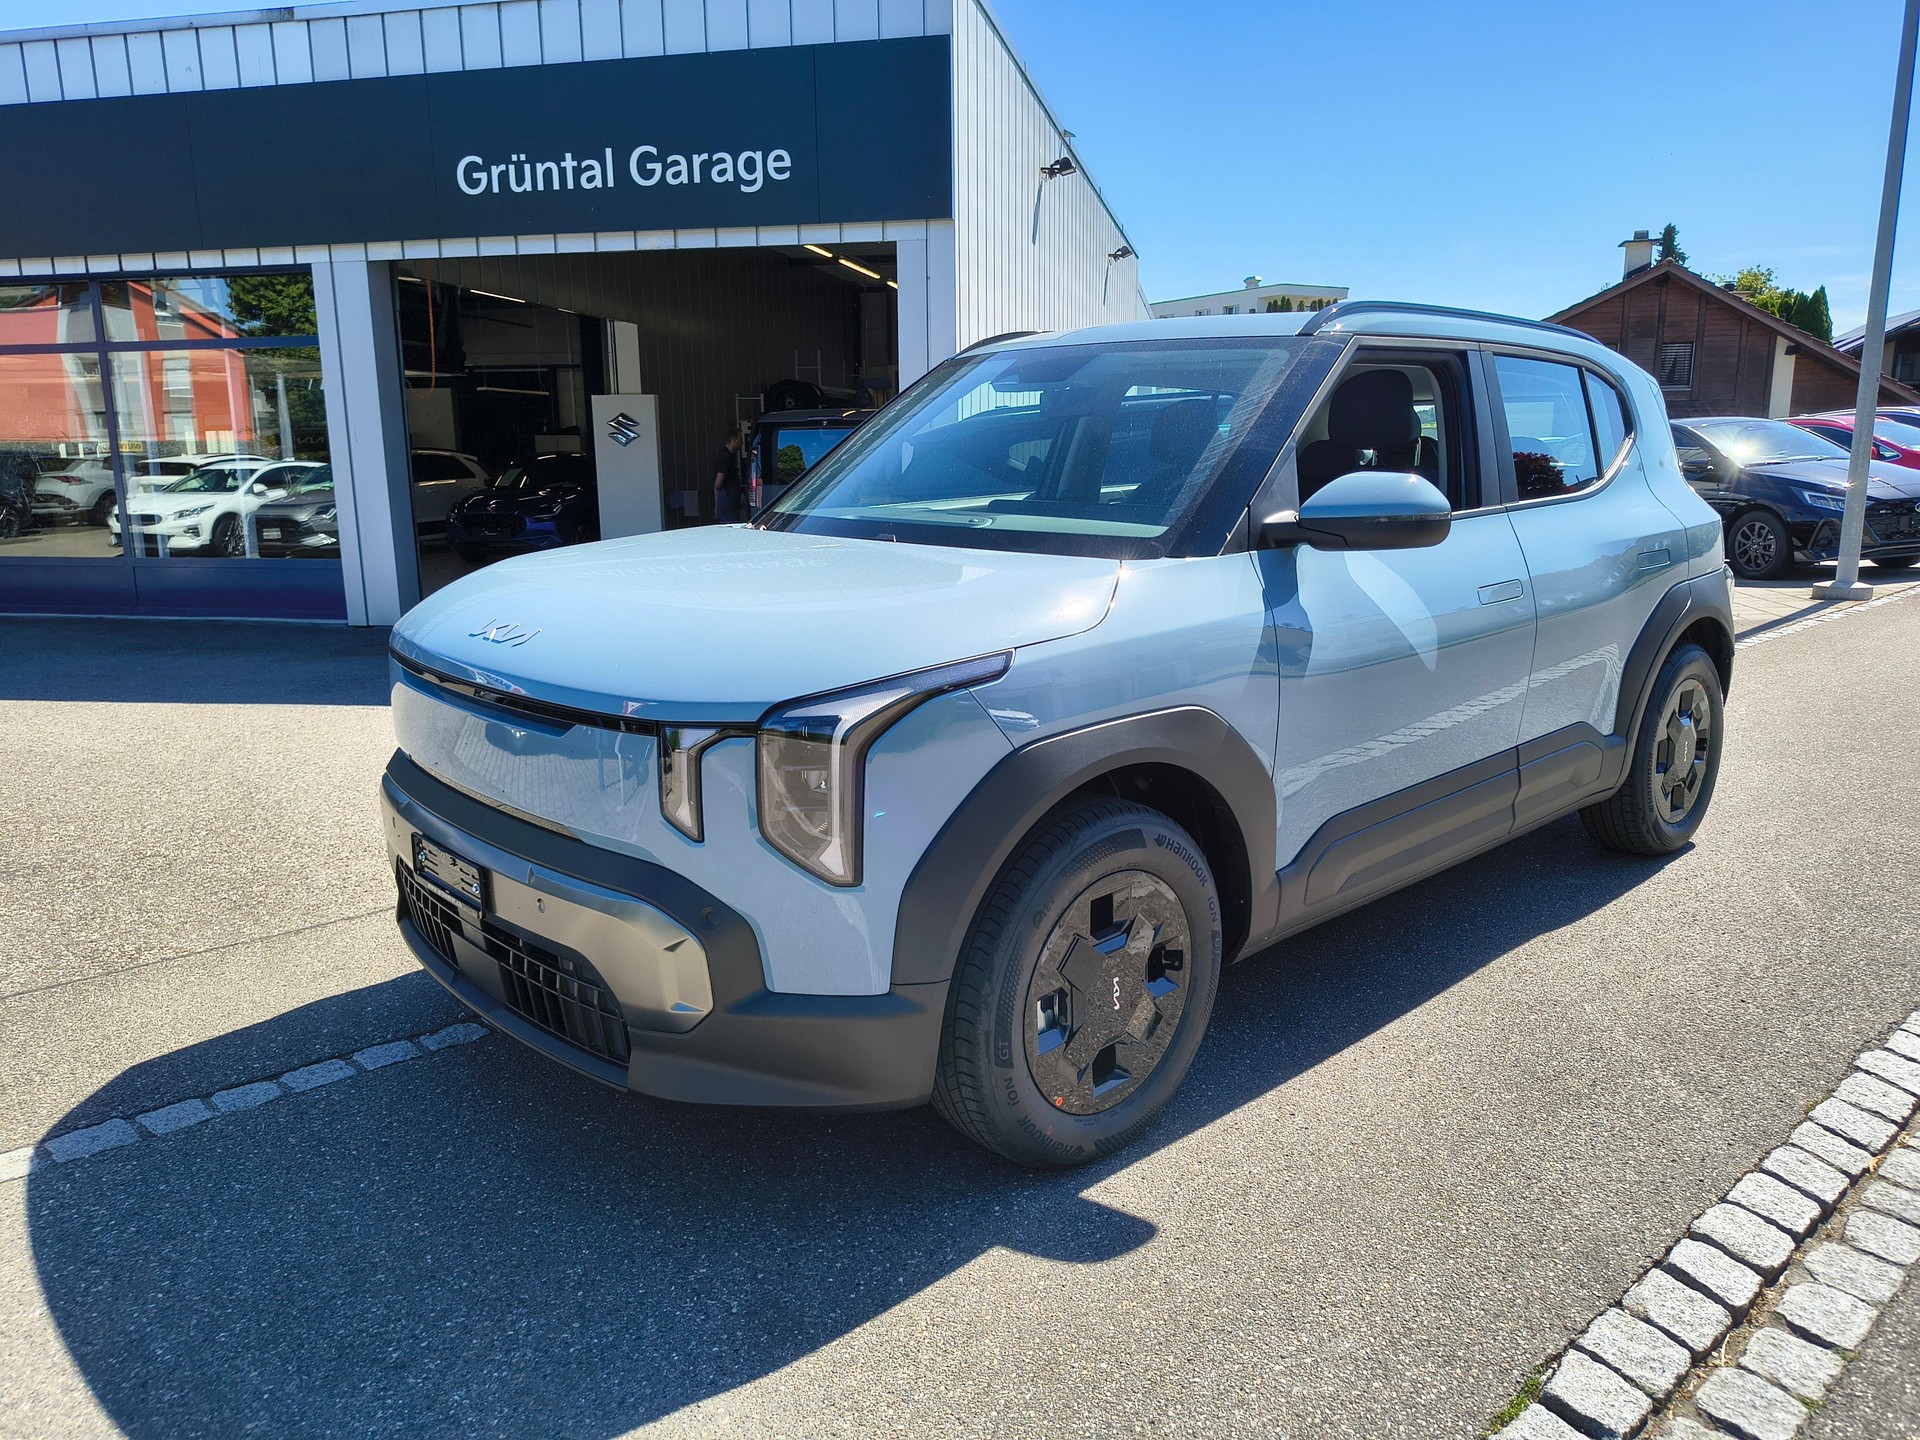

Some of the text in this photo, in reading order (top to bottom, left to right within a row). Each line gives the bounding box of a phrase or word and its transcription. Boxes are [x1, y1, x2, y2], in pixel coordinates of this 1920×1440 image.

[456, 145, 792, 195] Grüntal Garage
[999, 1040, 1010, 1060] GT
